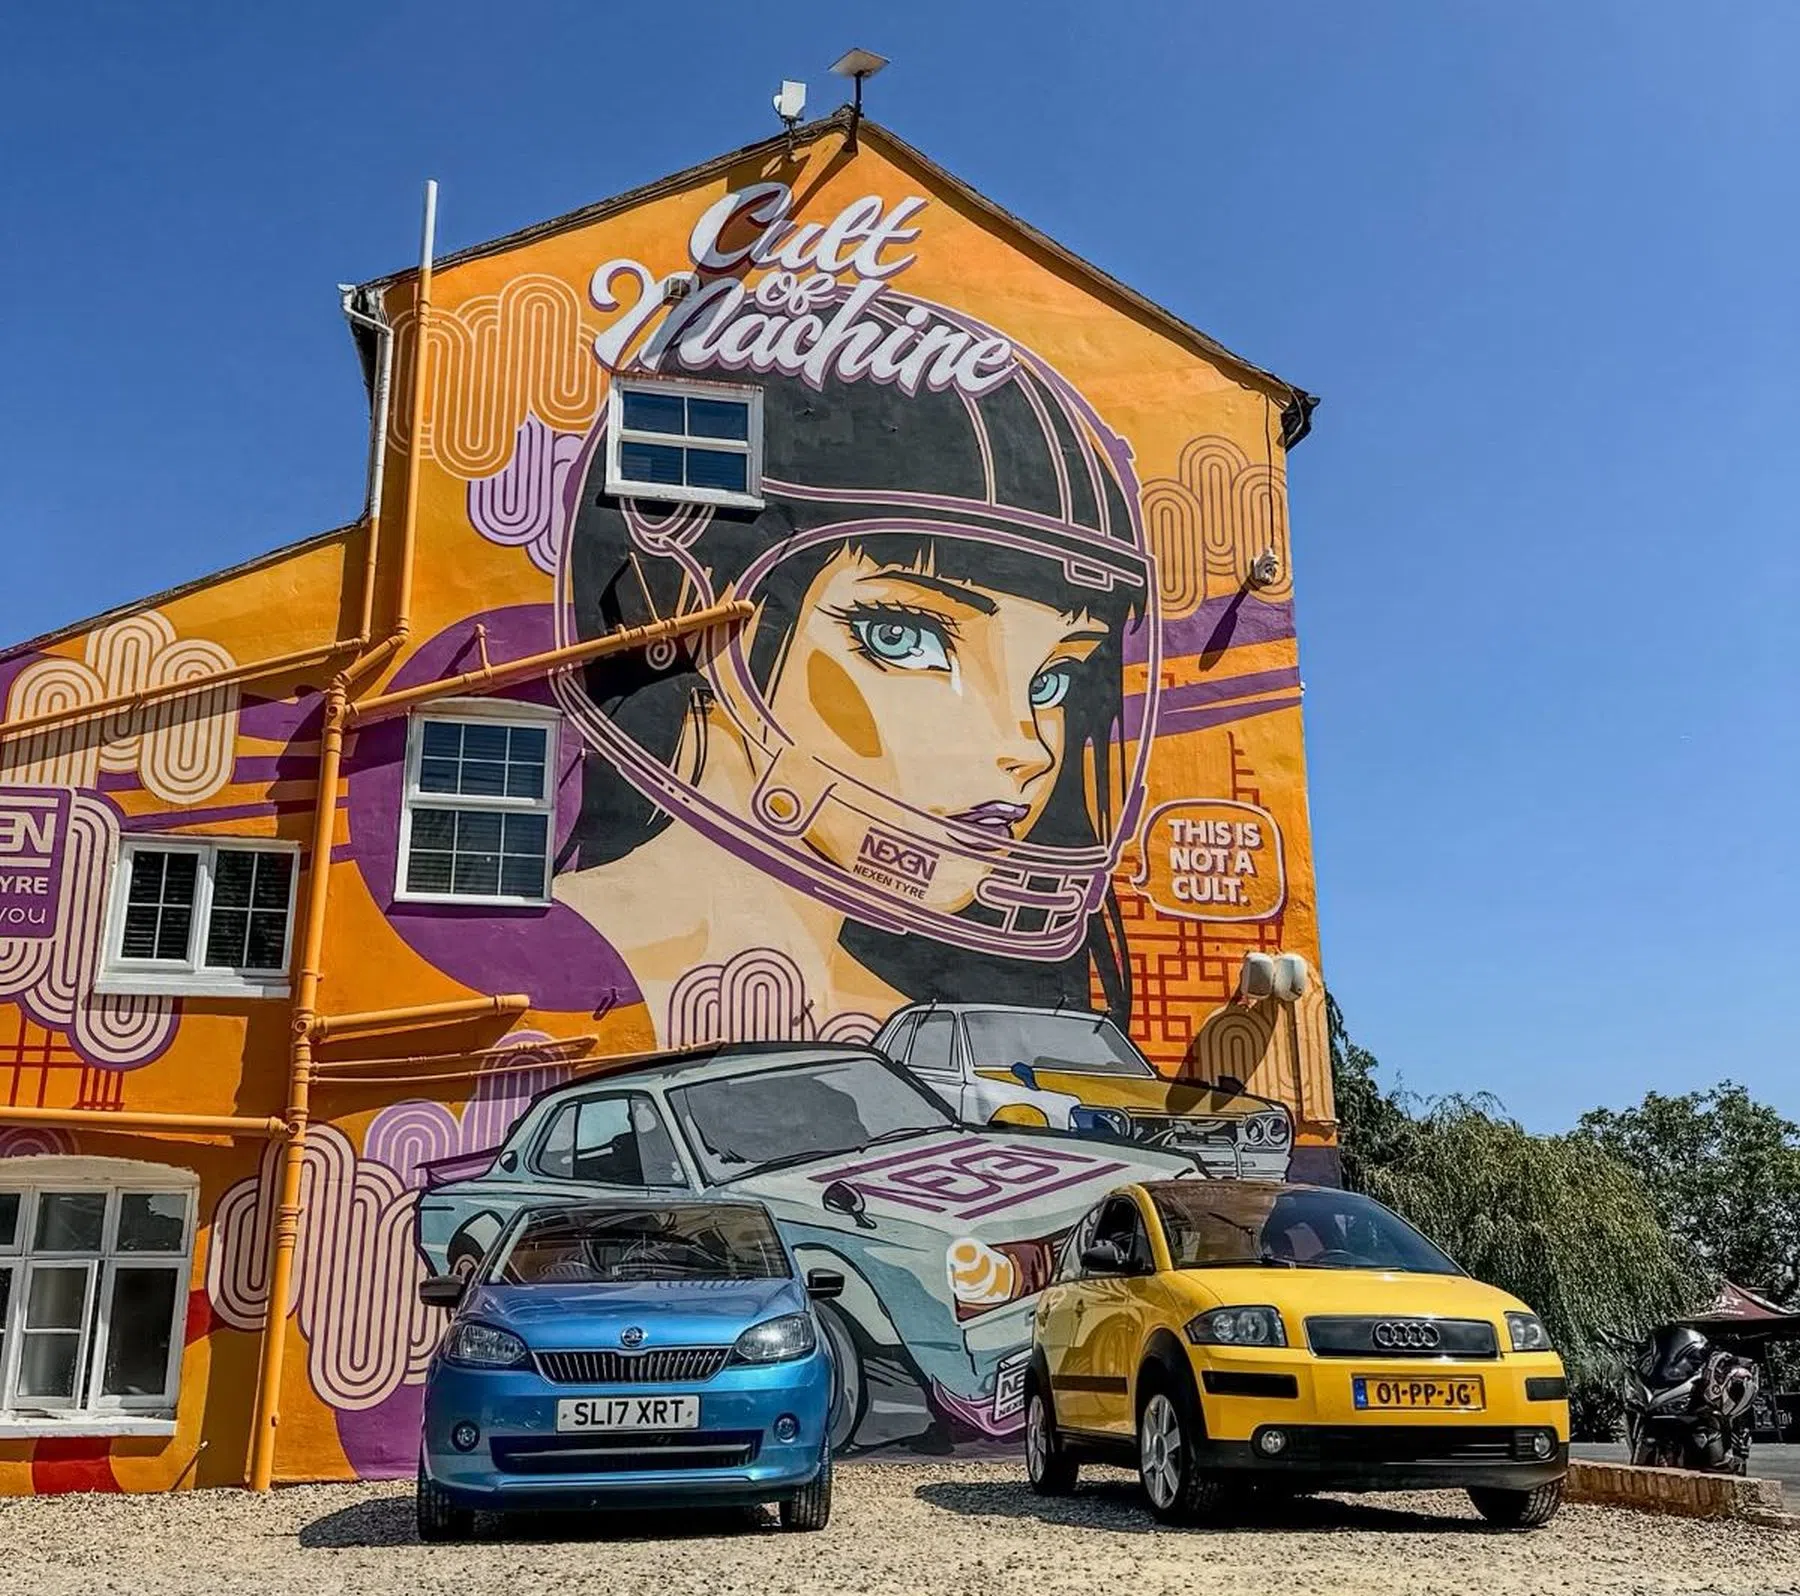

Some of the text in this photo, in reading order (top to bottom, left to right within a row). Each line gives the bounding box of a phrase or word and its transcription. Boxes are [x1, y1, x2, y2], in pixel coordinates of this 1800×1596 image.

[689, 182, 929, 279] Cult
[752, 271, 838, 314] of
[589, 258, 1019, 398] Machine
[1168, 819, 1263, 849] THIS IS
[860, 833, 937, 881] NEXEN
[1170, 847, 1257, 876] NOT A
[853, 864, 926, 900] NEXEN TYRE
[1171, 876, 1250, 904] CULT.
[1376, 1382, 1471, 1406] 01-PP-JG
[574, 1400, 684, 1426] SL17 XRT
